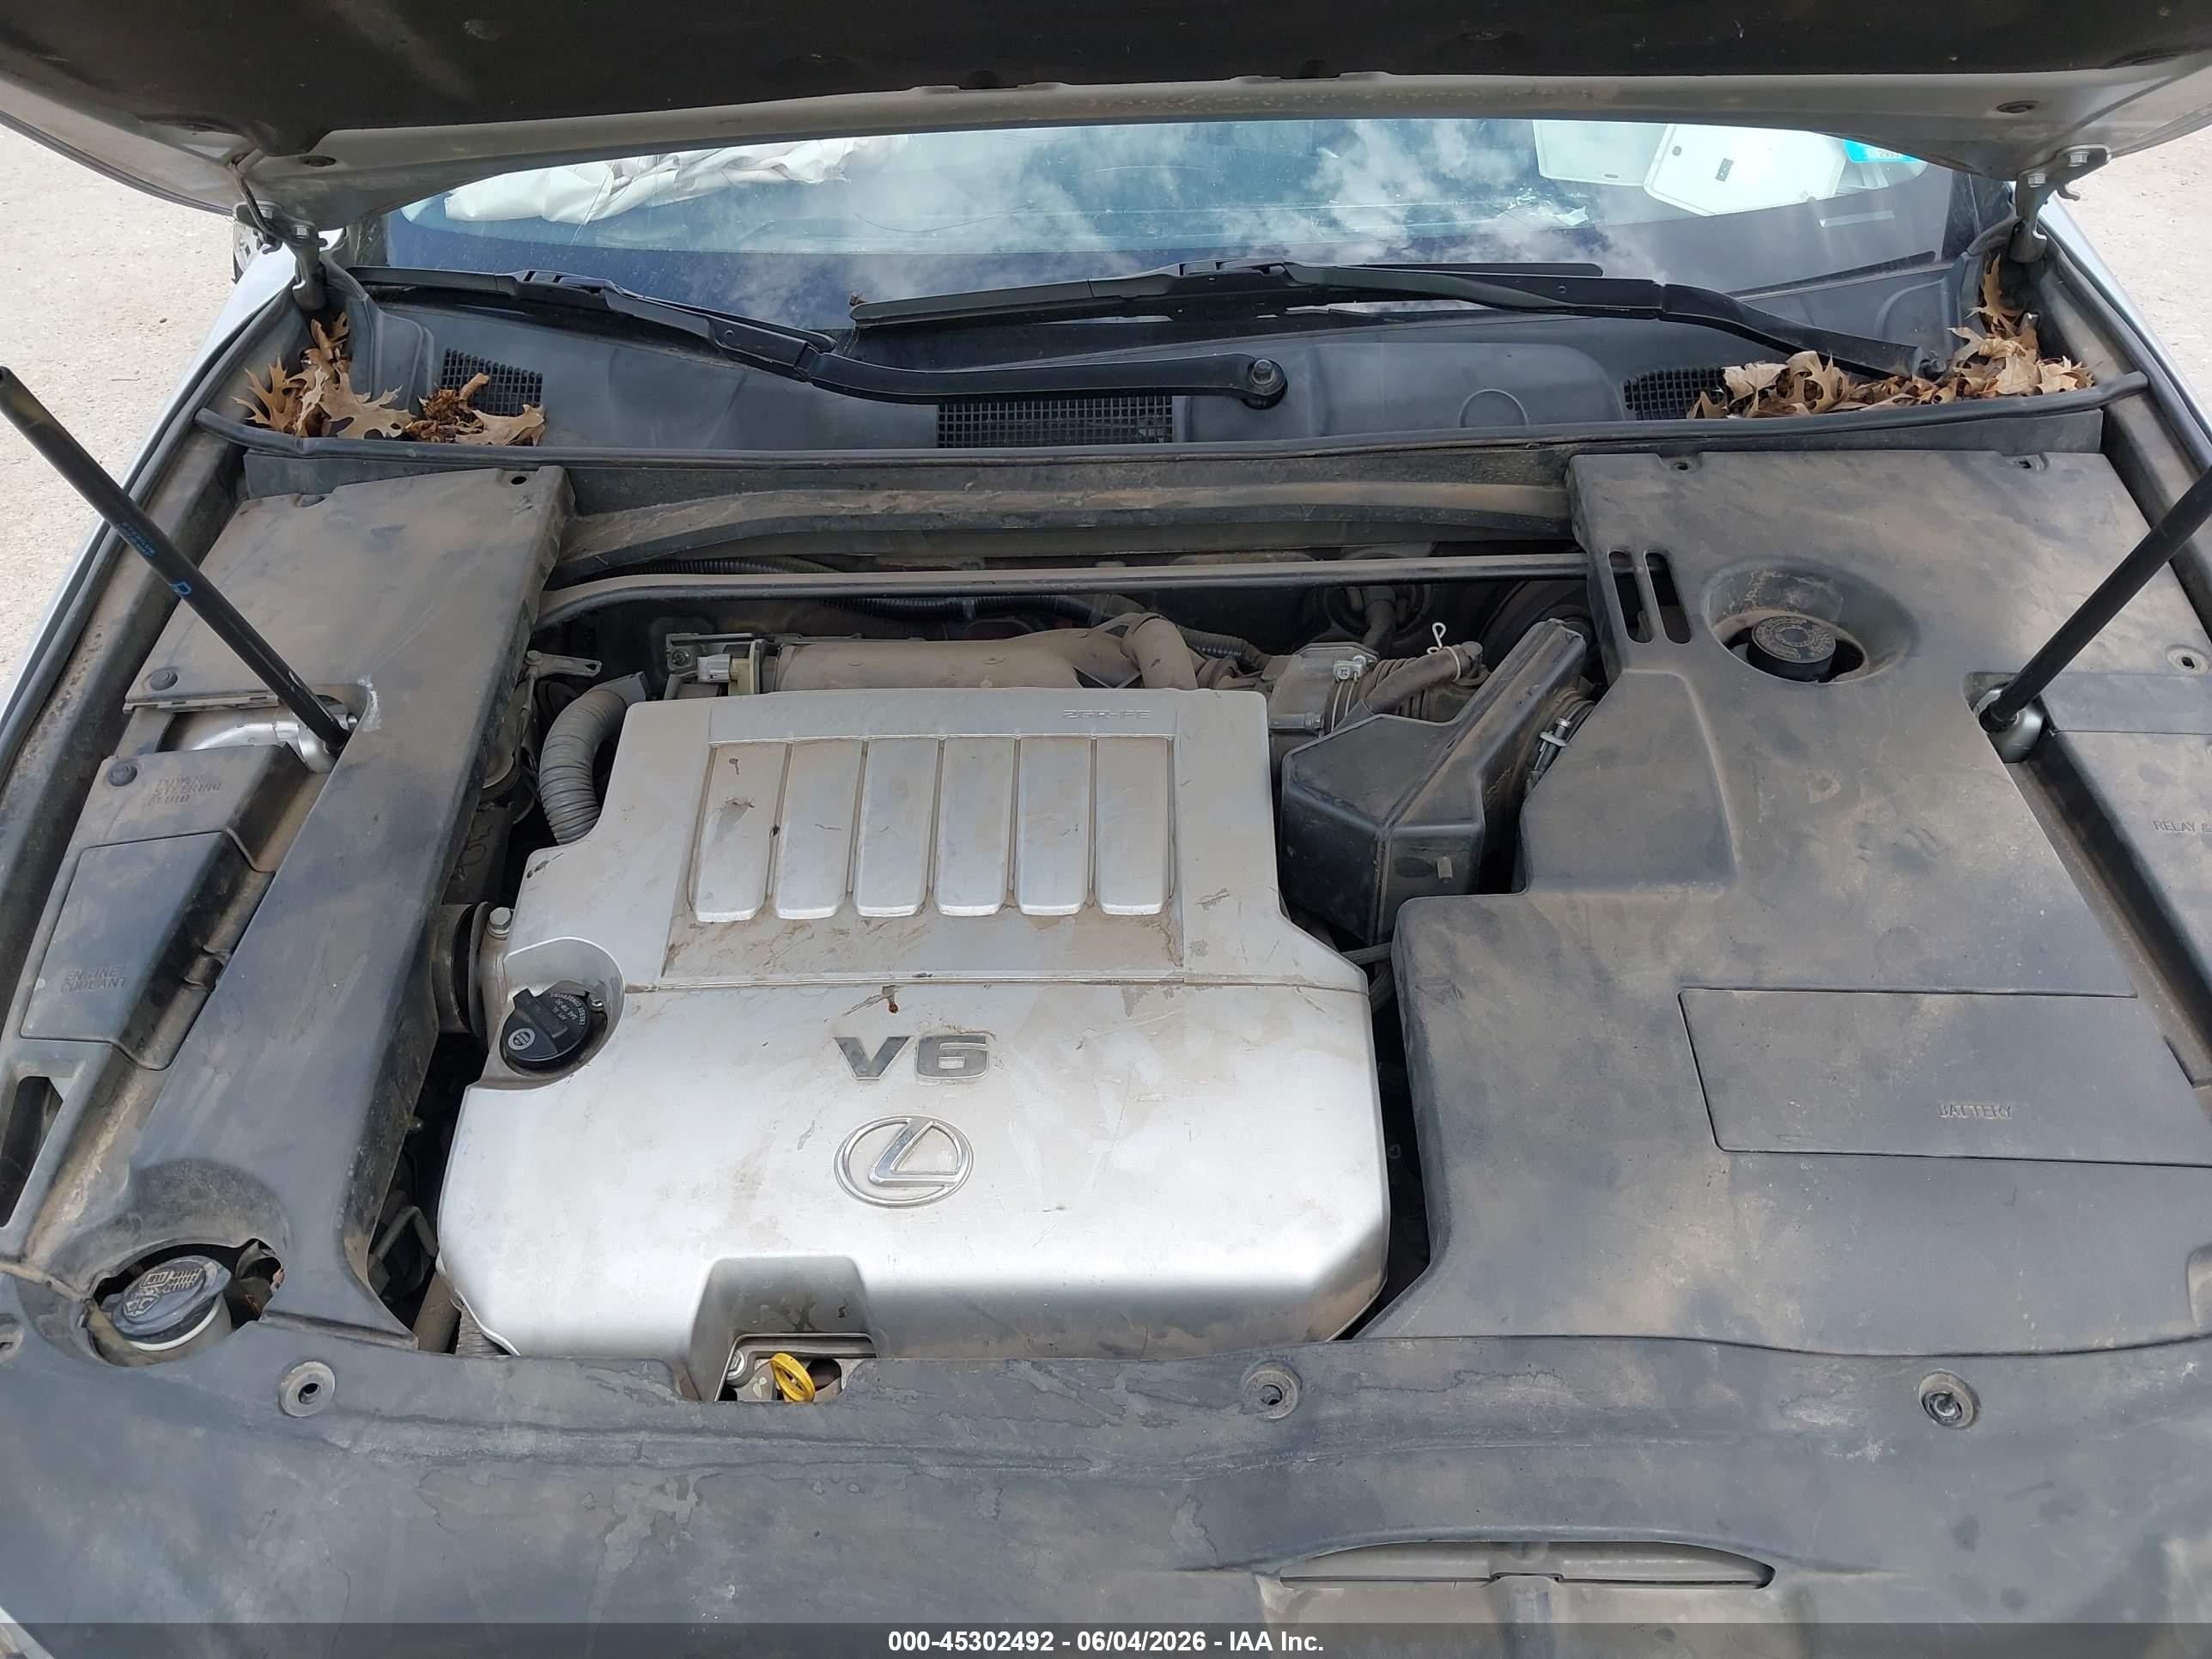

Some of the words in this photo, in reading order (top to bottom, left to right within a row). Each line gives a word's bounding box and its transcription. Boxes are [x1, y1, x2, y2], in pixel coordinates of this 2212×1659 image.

[1062, 709, 1152, 720] 2GR-FE
[2152, 820, 2196, 832] RELAY
[65, 966, 118, 981] ENGINE
[60, 977, 126, 993] COOLANT
[832, 1036, 988, 1080] V6
[1938, 1104, 2012, 1119] BATTERY
